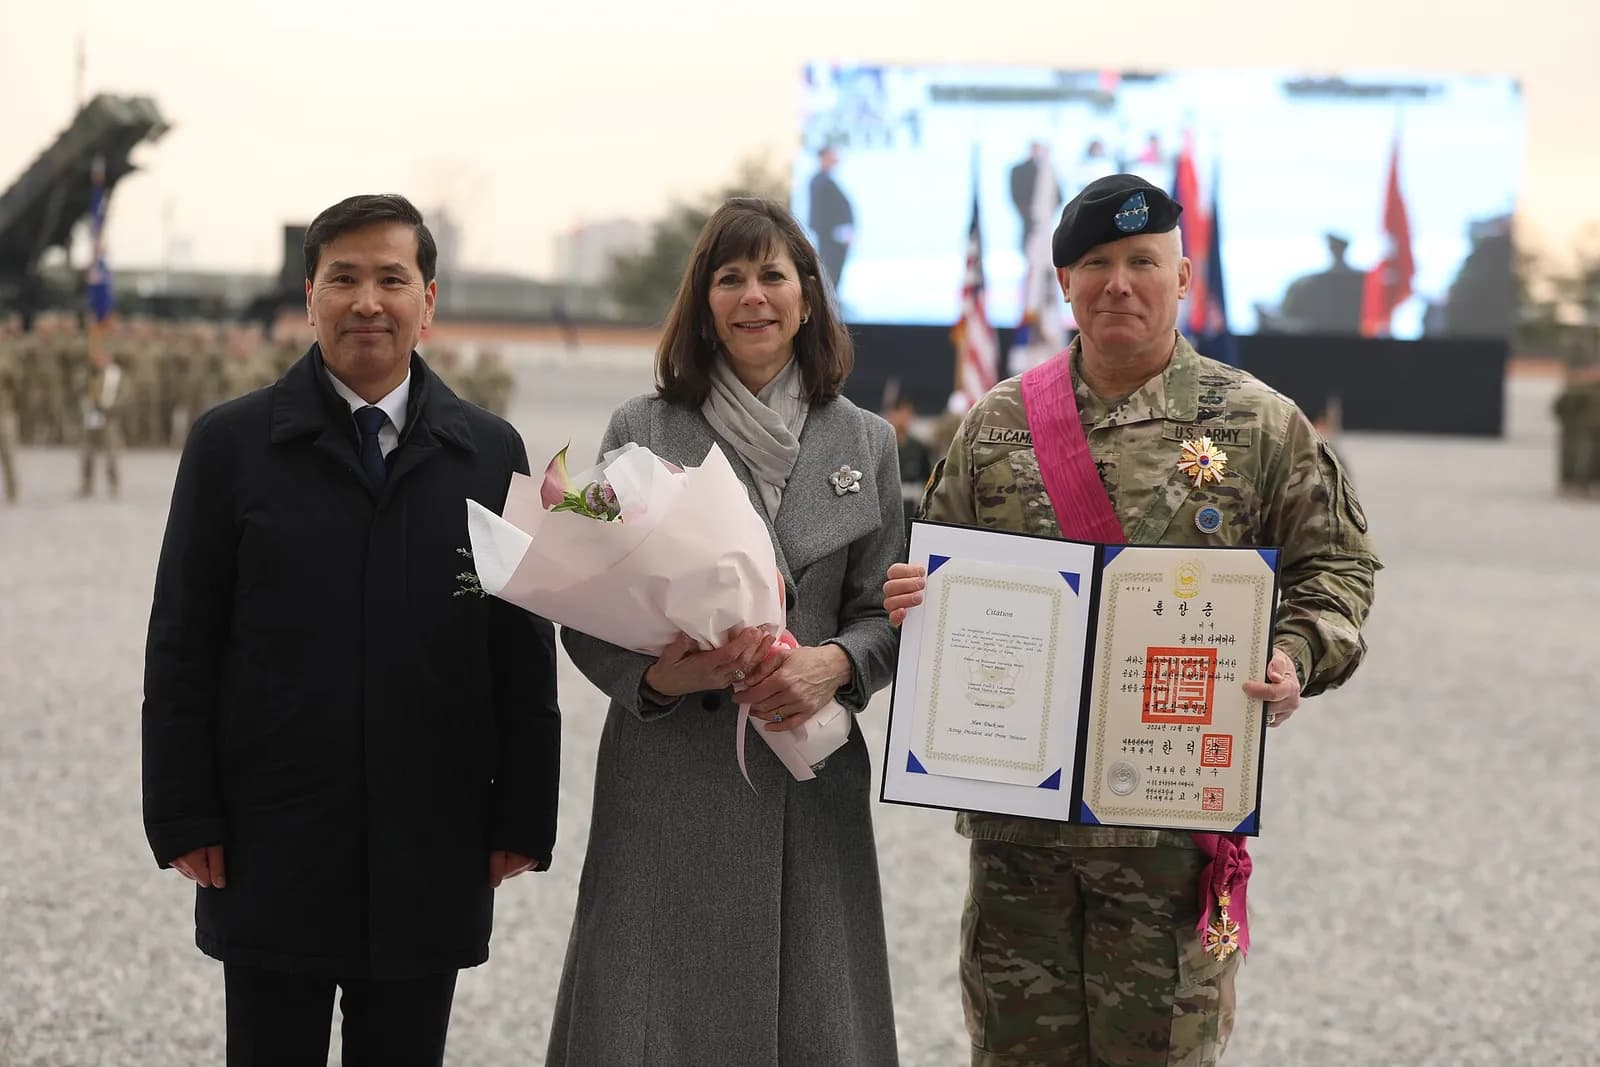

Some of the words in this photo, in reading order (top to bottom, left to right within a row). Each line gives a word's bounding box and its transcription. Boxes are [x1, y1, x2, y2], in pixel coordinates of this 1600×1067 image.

[1175, 426, 1196, 440] U.S.
[1204, 428, 1241, 443] ARMY
[985, 608, 1014, 618] Citation
